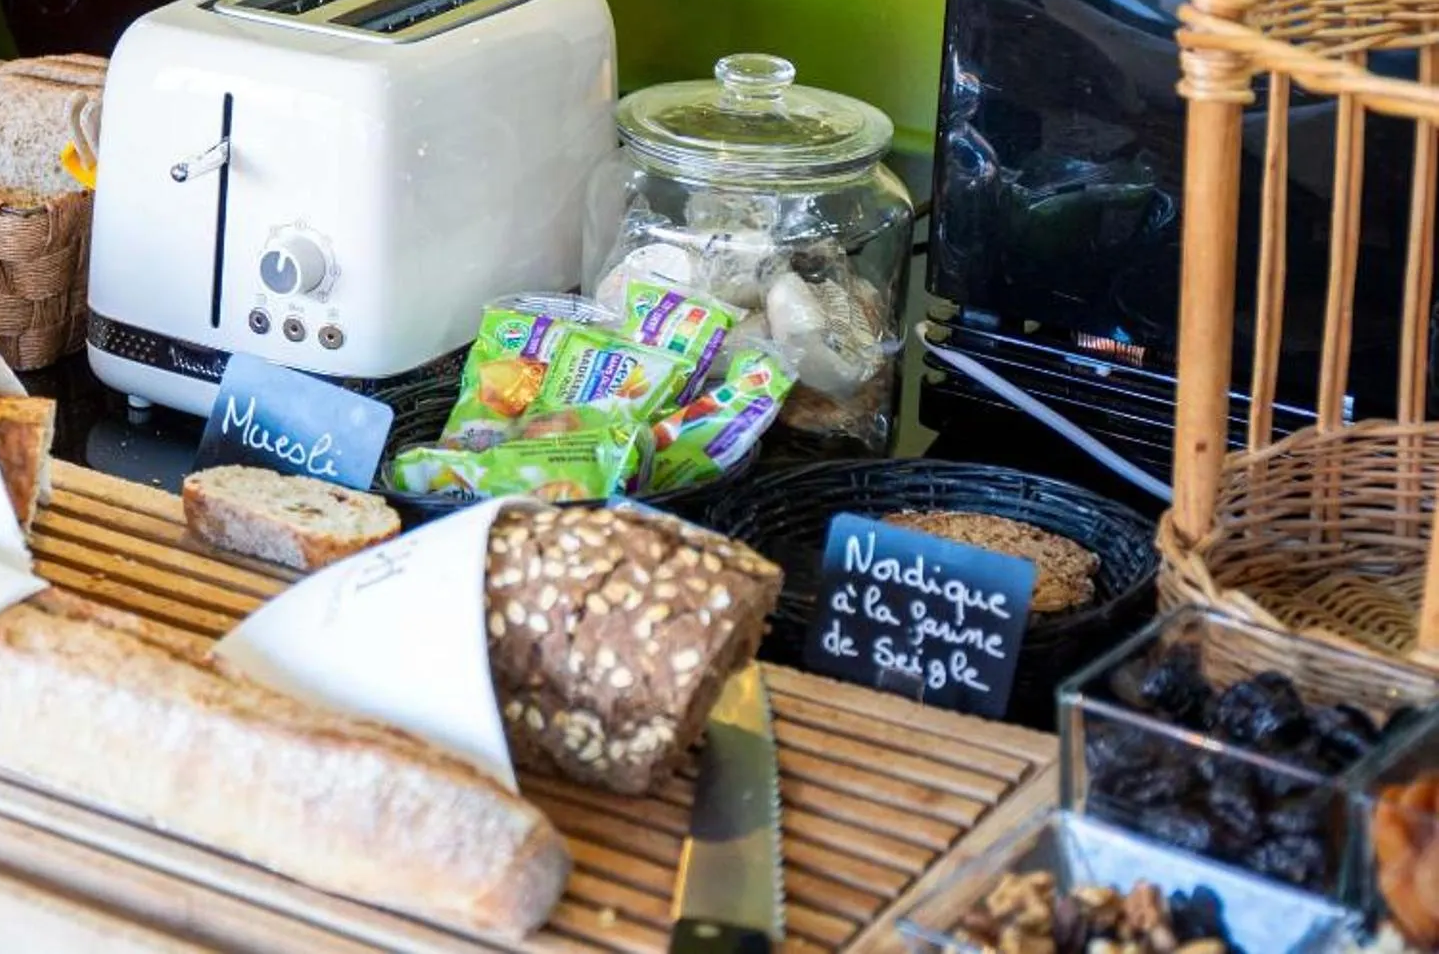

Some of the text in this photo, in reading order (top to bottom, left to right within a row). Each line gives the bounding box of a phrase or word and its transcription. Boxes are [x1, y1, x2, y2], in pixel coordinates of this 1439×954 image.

[222, 395, 339, 476] Muesli
[831, 583, 858, 615] à
[862, 585, 901, 627] la
[844, 530, 1011, 626] Nordique
[821, 618, 992, 692] de Seigle
